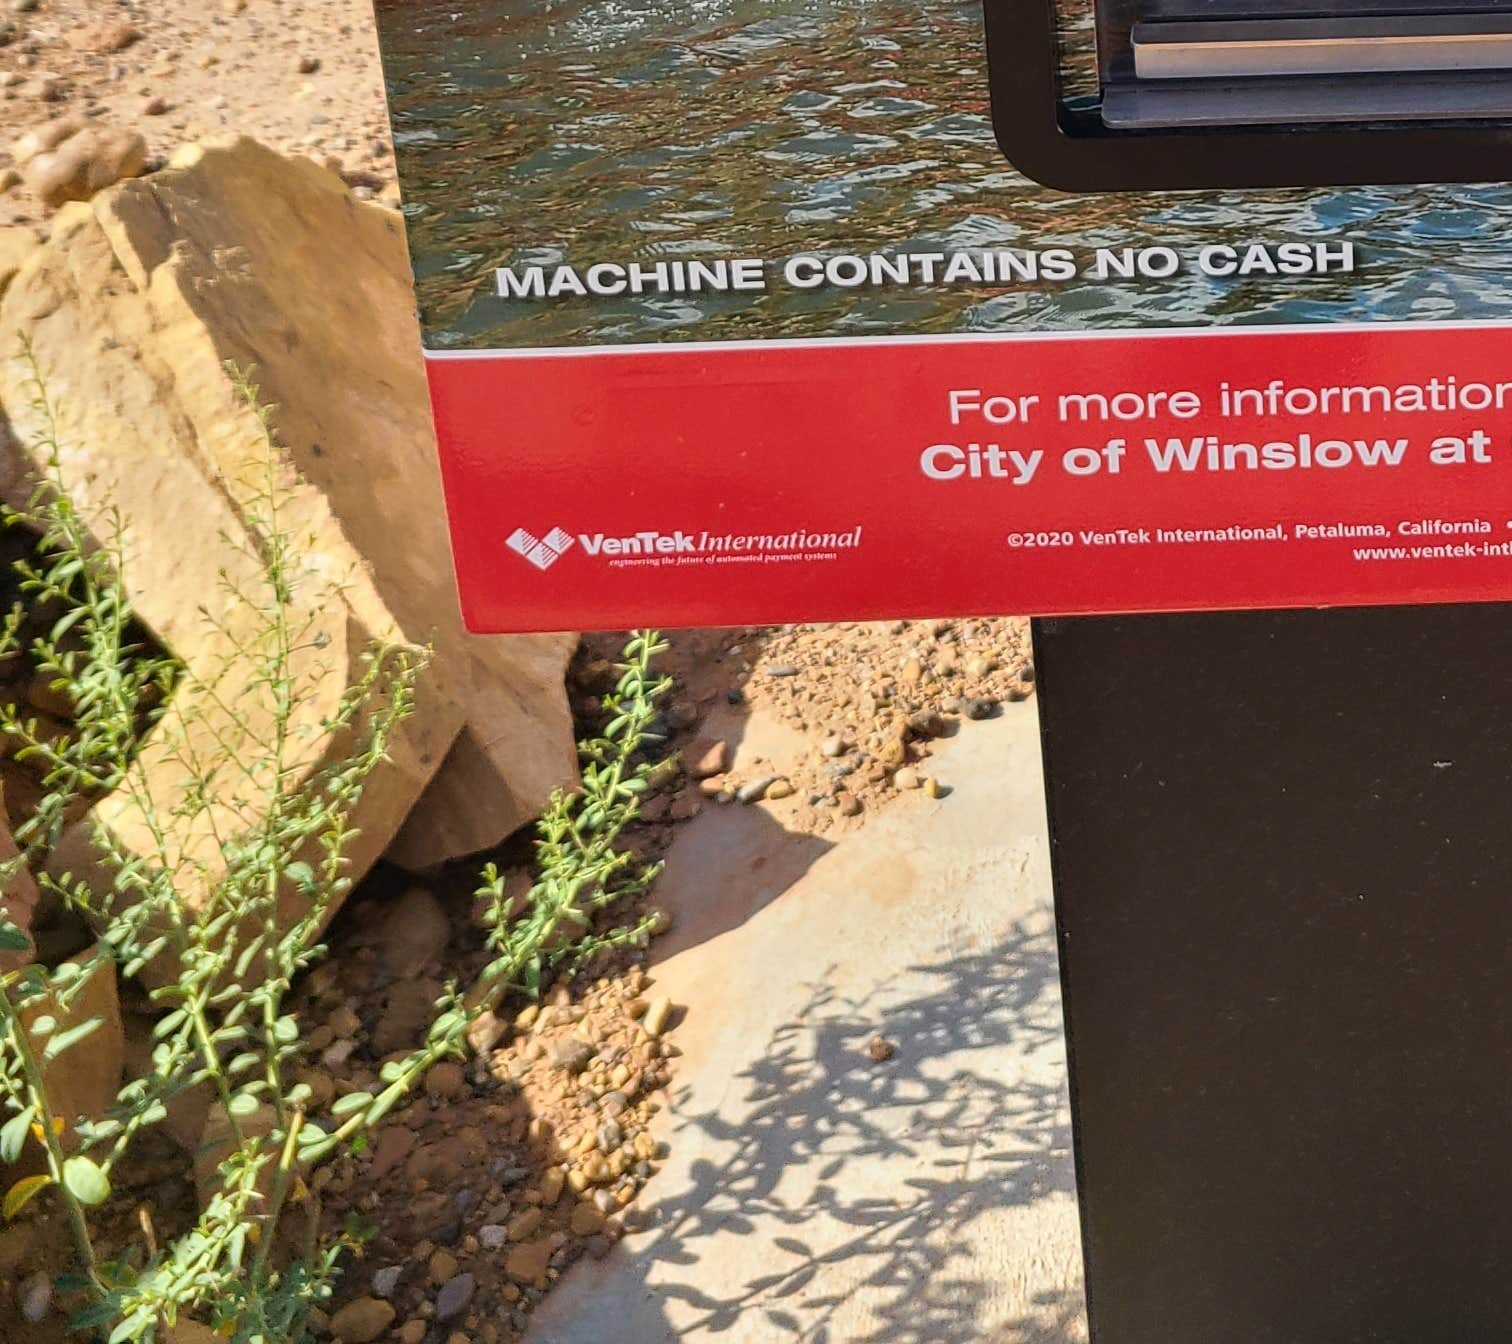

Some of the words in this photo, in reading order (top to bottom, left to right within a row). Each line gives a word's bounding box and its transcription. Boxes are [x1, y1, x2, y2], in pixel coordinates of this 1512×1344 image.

[496, 259, 766, 297] MACHINE
[784, 249, 1076, 289] CONTAINS
[1099, 247, 1181, 278] NO
[1200, 241, 1355, 277] CASH
[948, 390, 1038, 424] For
[1058, 389, 1200, 421] more
[919, 444, 1043, 485] City
[1061, 439, 1125, 475] of
[1144, 434, 1408, 472] Winslow
[1429, 429, 1492, 465] at
[578, 530, 696, 556] VenTek
[698, 526, 863, 551] International
[1080, 528, 1150, 545] VenTek
[1156, 524, 1289, 543] International,
[1295, 522, 1391, 539] Petaluma,
[1398, 518, 1492, 535] California
